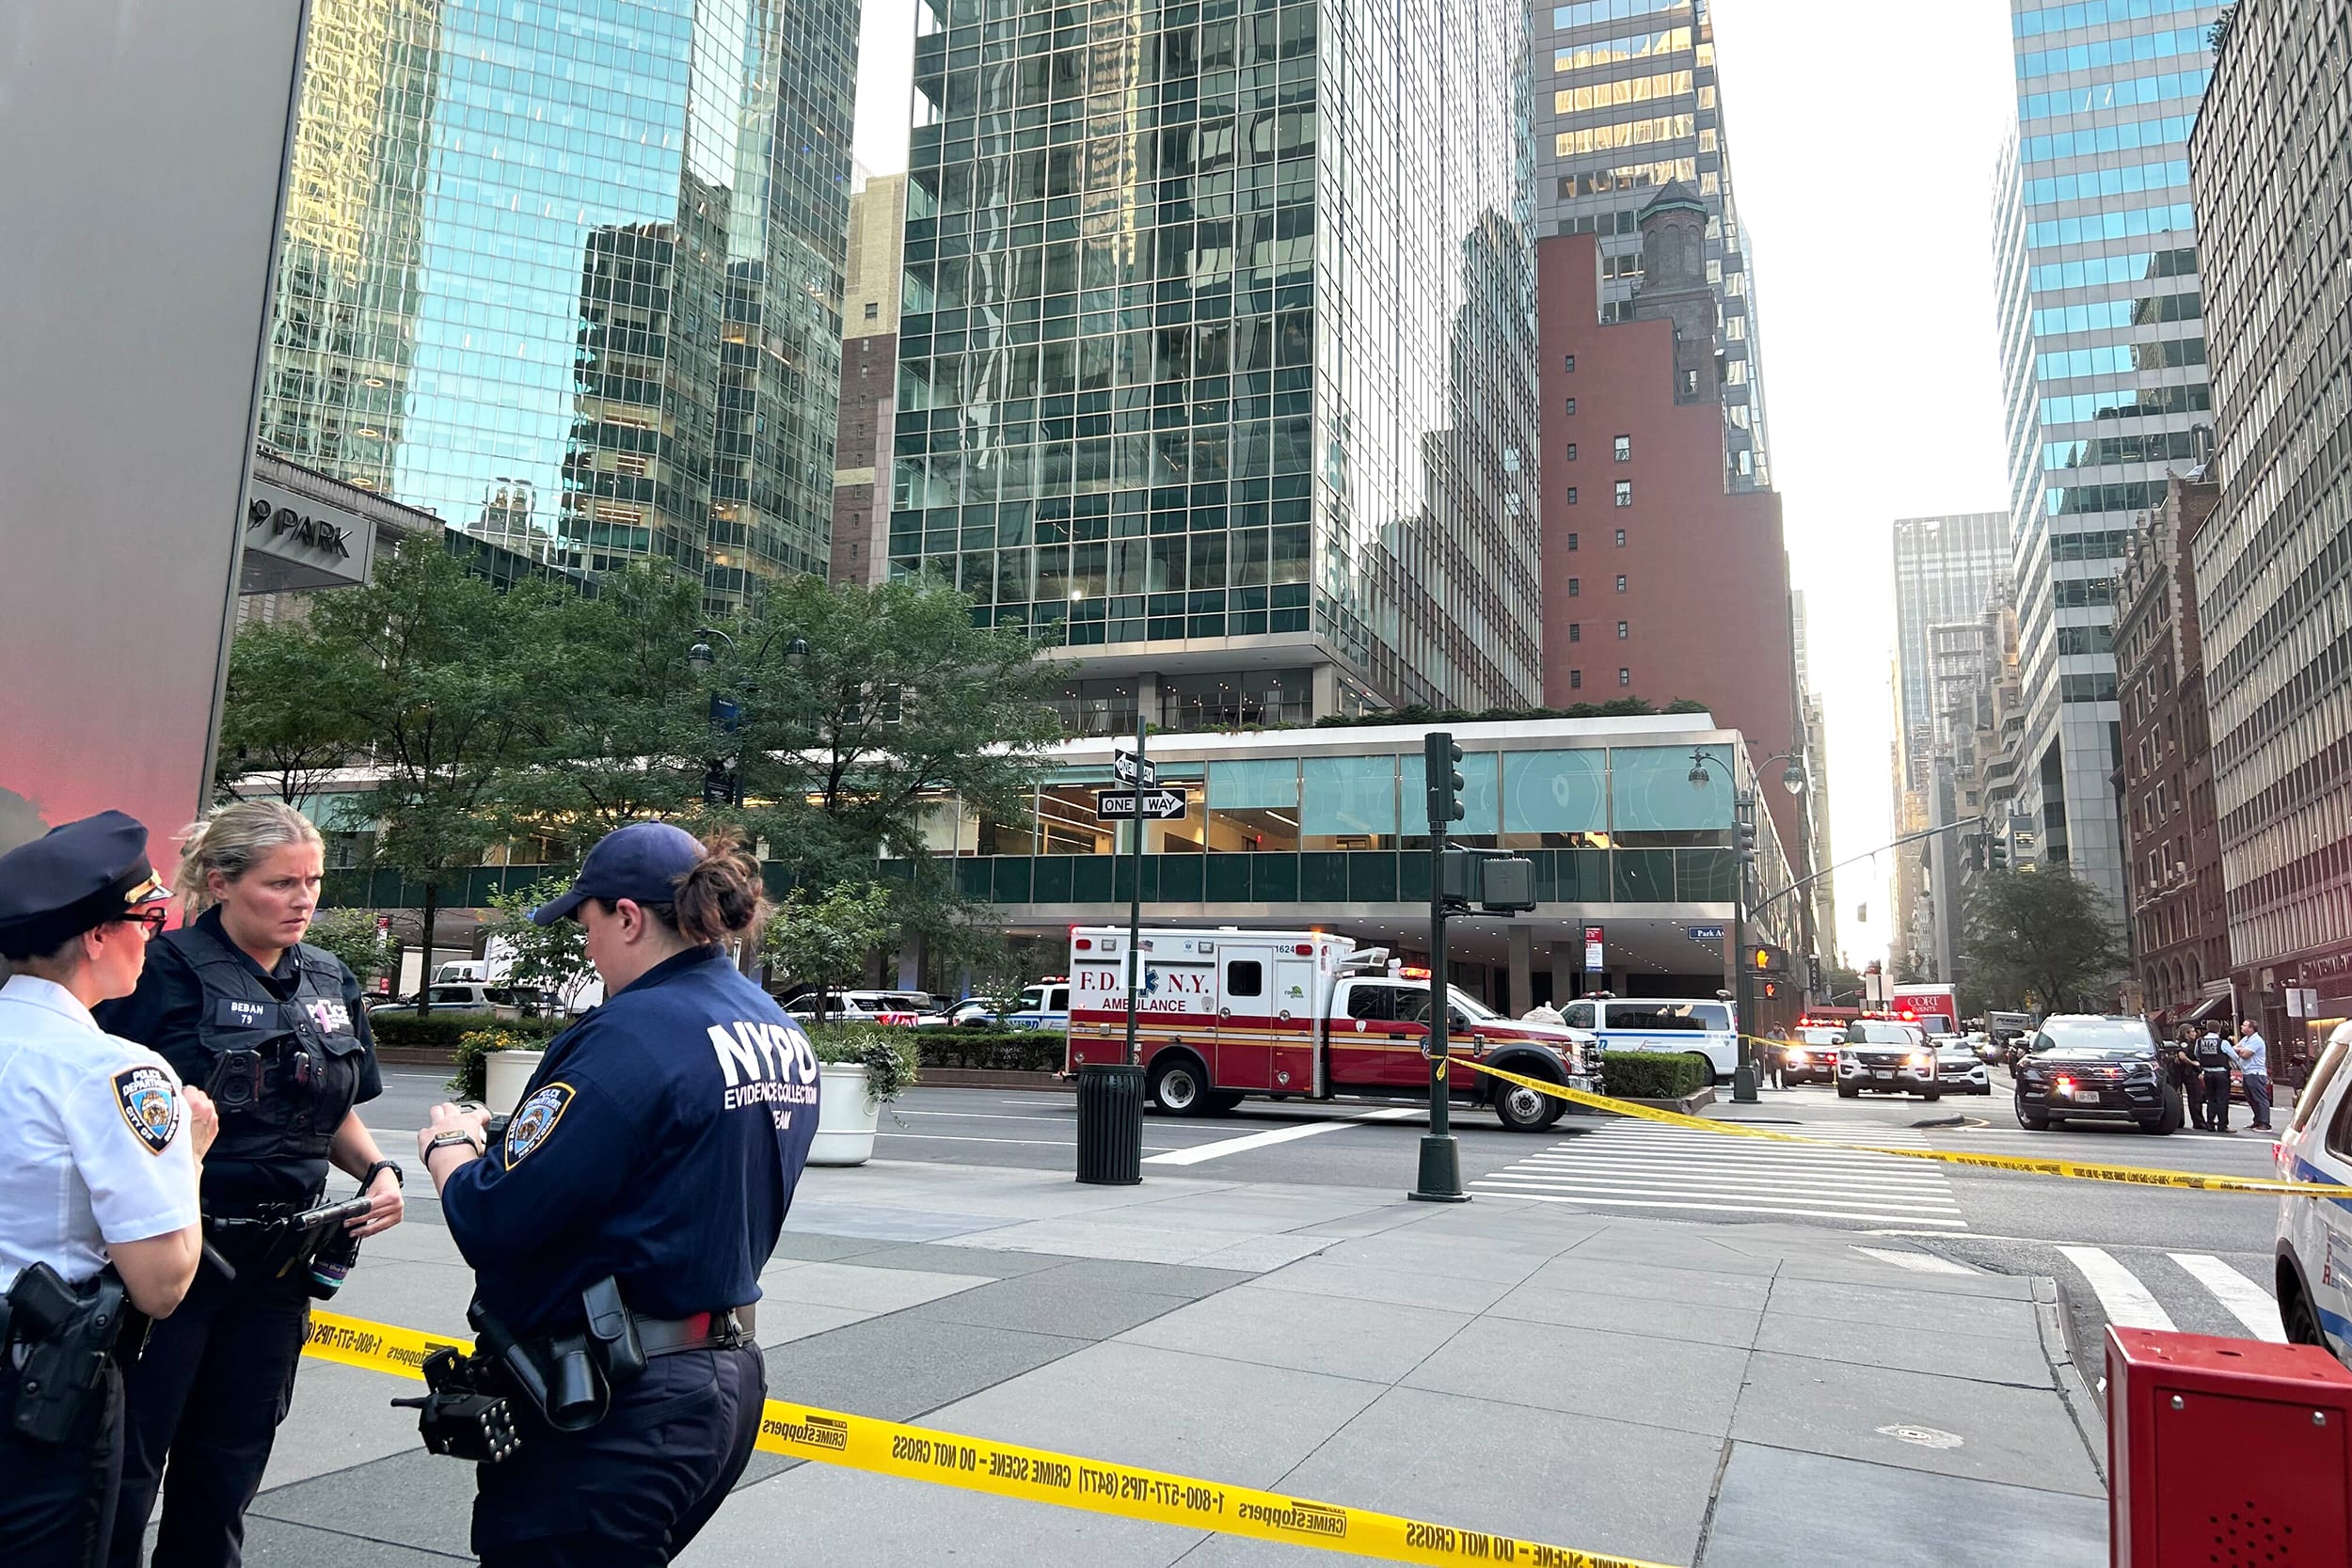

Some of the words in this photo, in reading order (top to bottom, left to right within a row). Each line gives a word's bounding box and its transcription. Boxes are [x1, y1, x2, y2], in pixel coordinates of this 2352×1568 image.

[274, 508, 354, 559] PARK
[1119, 759, 1133, 775] ONE
[1104, 799, 1133, 811] ONE
[1147, 799, 1176, 810] WAY
[1275, 944, 1295, 954] 1624
[1079, 972, 1120, 990] F.D.
[1168, 974, 1209, 993] N.Y.
[230, 1001, 263, 1014] BEBAN
[1907, 996, 1940, 1006] CORT
[241, 1014, 252, 1024] 79
[707, 1022, 817, 1086] NYPD
[724, 1082, 777, 1110] EVIDENCE
[125, 1105, 143, 1128] CITY
